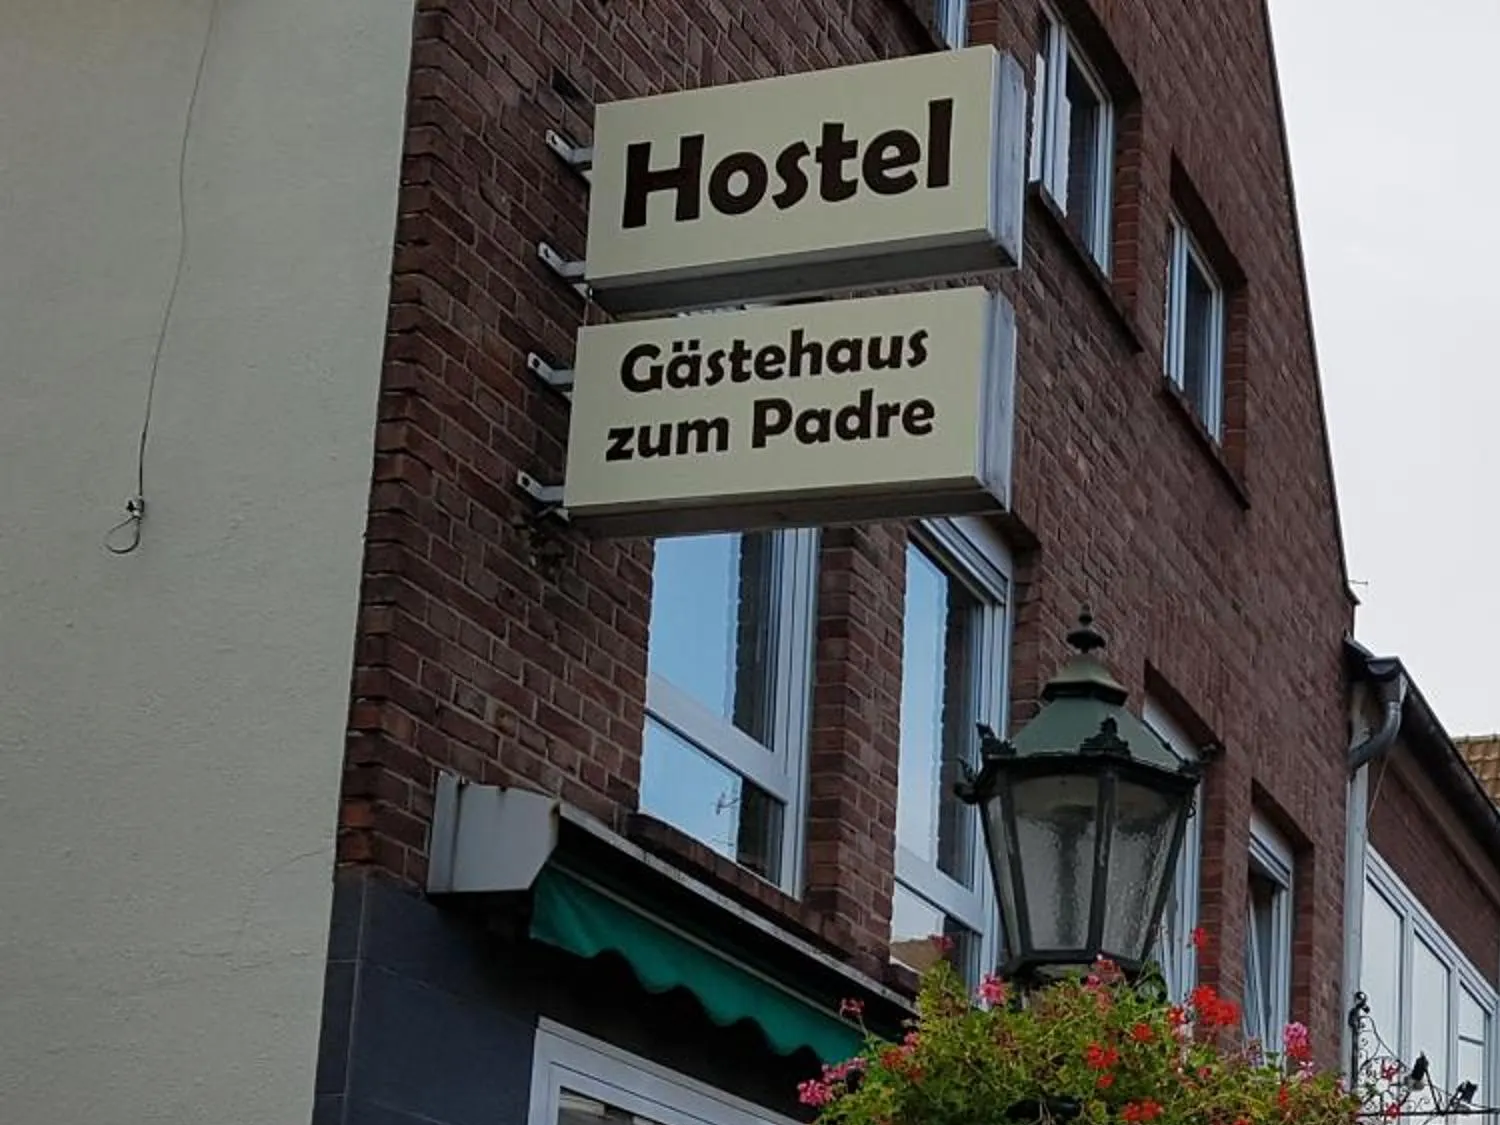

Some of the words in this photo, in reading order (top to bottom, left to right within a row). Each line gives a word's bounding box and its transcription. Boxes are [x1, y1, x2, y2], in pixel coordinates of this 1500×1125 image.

[622, 98, 954, 229] Hostel
[620, 328, 929, 393] Gästehaus
[605, 414, 730, 462] zum
[751, 389, 936, 449] Padre
